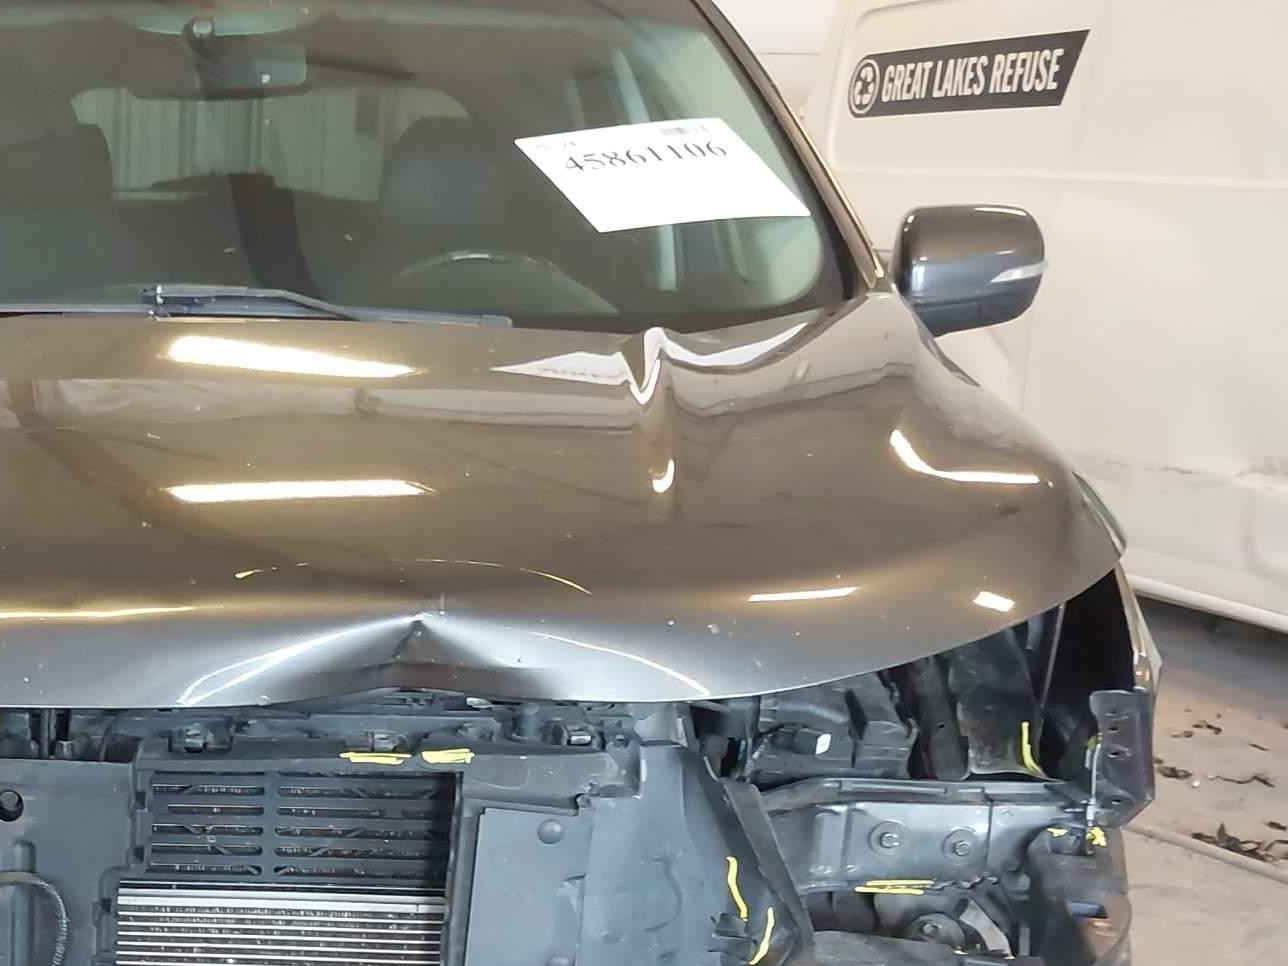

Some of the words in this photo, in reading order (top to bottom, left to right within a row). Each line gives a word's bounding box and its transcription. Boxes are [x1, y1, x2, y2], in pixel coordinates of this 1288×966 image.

[881, 61, 933, 103] GREAT
[932, 55, 989, 99] LAKES
[988, 48, 1065, 95] REFUSE
[565, 141, 727, 171] 45861106
